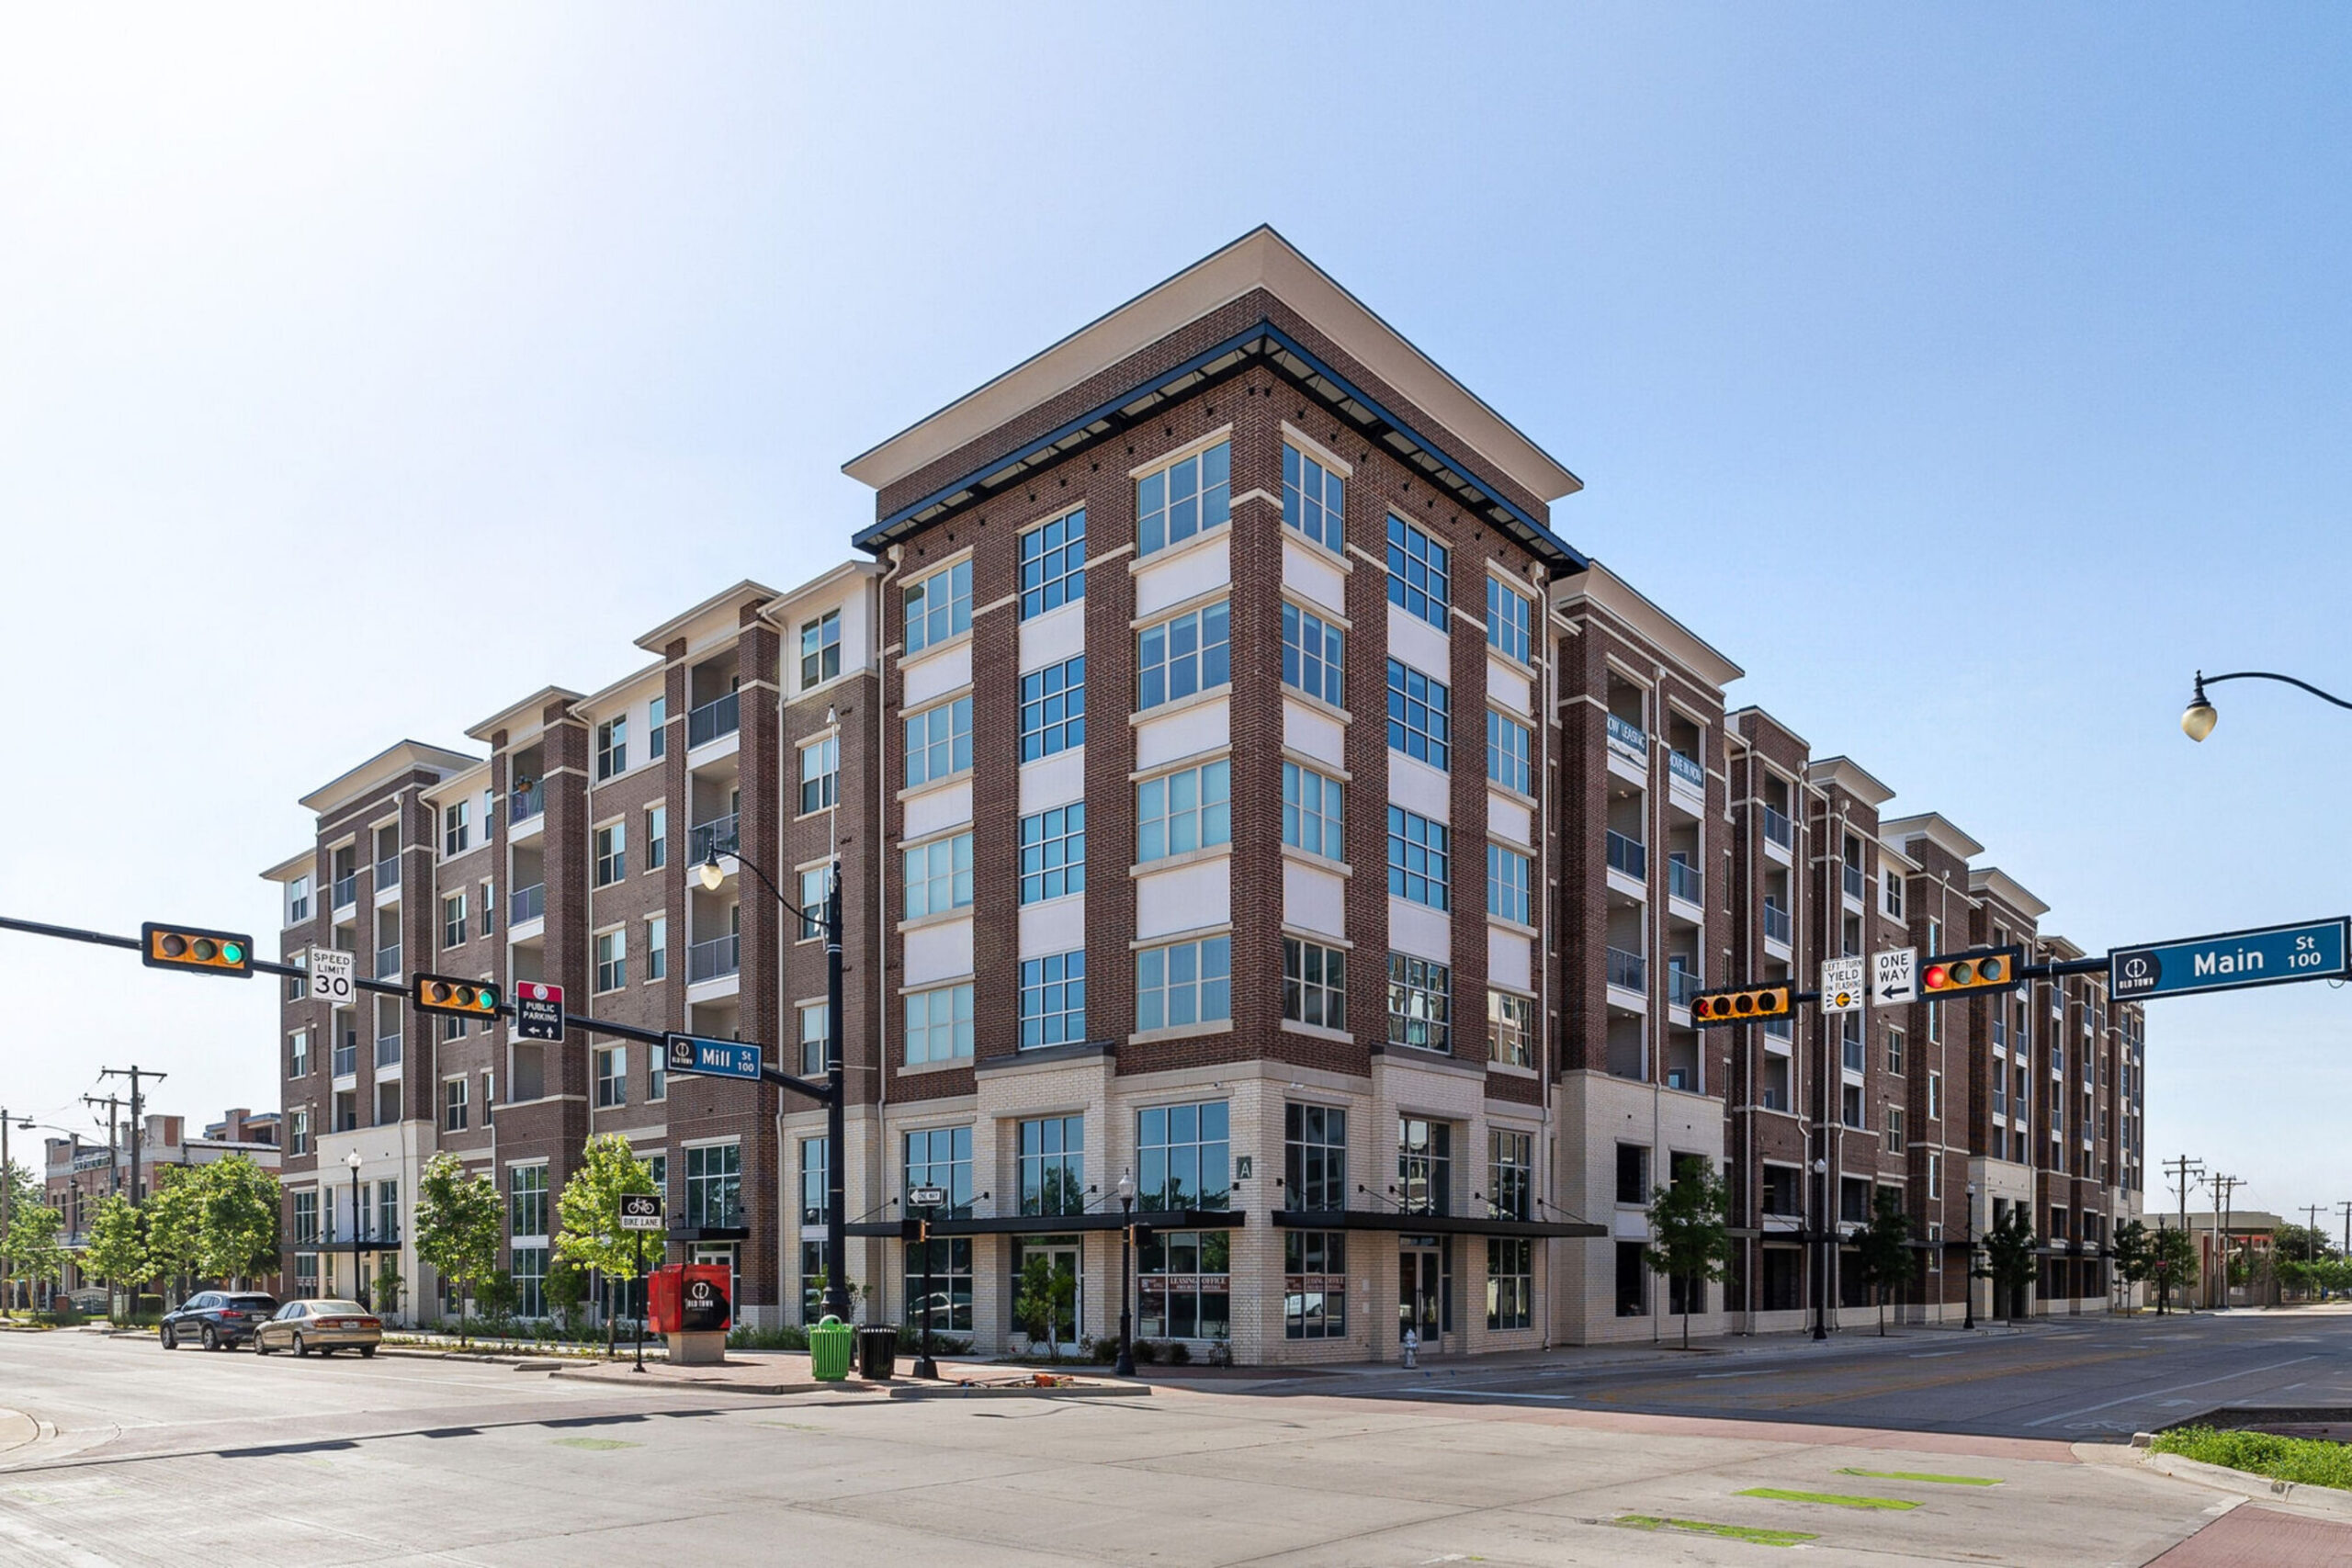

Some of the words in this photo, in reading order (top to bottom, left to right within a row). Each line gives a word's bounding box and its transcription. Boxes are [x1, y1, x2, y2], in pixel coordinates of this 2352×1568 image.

[2295, 935, 2315, 951] St
[313, 953, 350, 965] SPEED
[1880, 953, 1909, 968] ONE
[2194, 947, 2264, 977] Main
[2287, 952, 2322, 968] 100
[318, 964, 345, 975] LIMIT
[1824, 963, 1840, 972] LEFT
[1845, 960, 1862, 969] TURN
[1827, 969, 1859, 982] YIELD
[1879, 966, 1910, 983] WAY
[315, 975, 349, 996] 30
[1835, 980, 1861, 990] FLASHING
[2119, 979, 2132, 989] OLD
[2133, 976, 2154, 987] TOWN
[526, 1001, 555, 1013] PUBLIC
[523, 1010, 559, 1023] PARKING
[702, 1047, 730, 1067] Mill
[741, 1051, 752, 1061] St
[737, 1062, 754, 1073] 100
[1240, 1162, 1250, 1178] A
[624, 1218, 639, 1226] BIKE
[640, 1218, 659, 1227] LANE
[1170, 1277, 1198, 1285] LEASING
[1201, 1277, 1227, 1285] OFFICE
